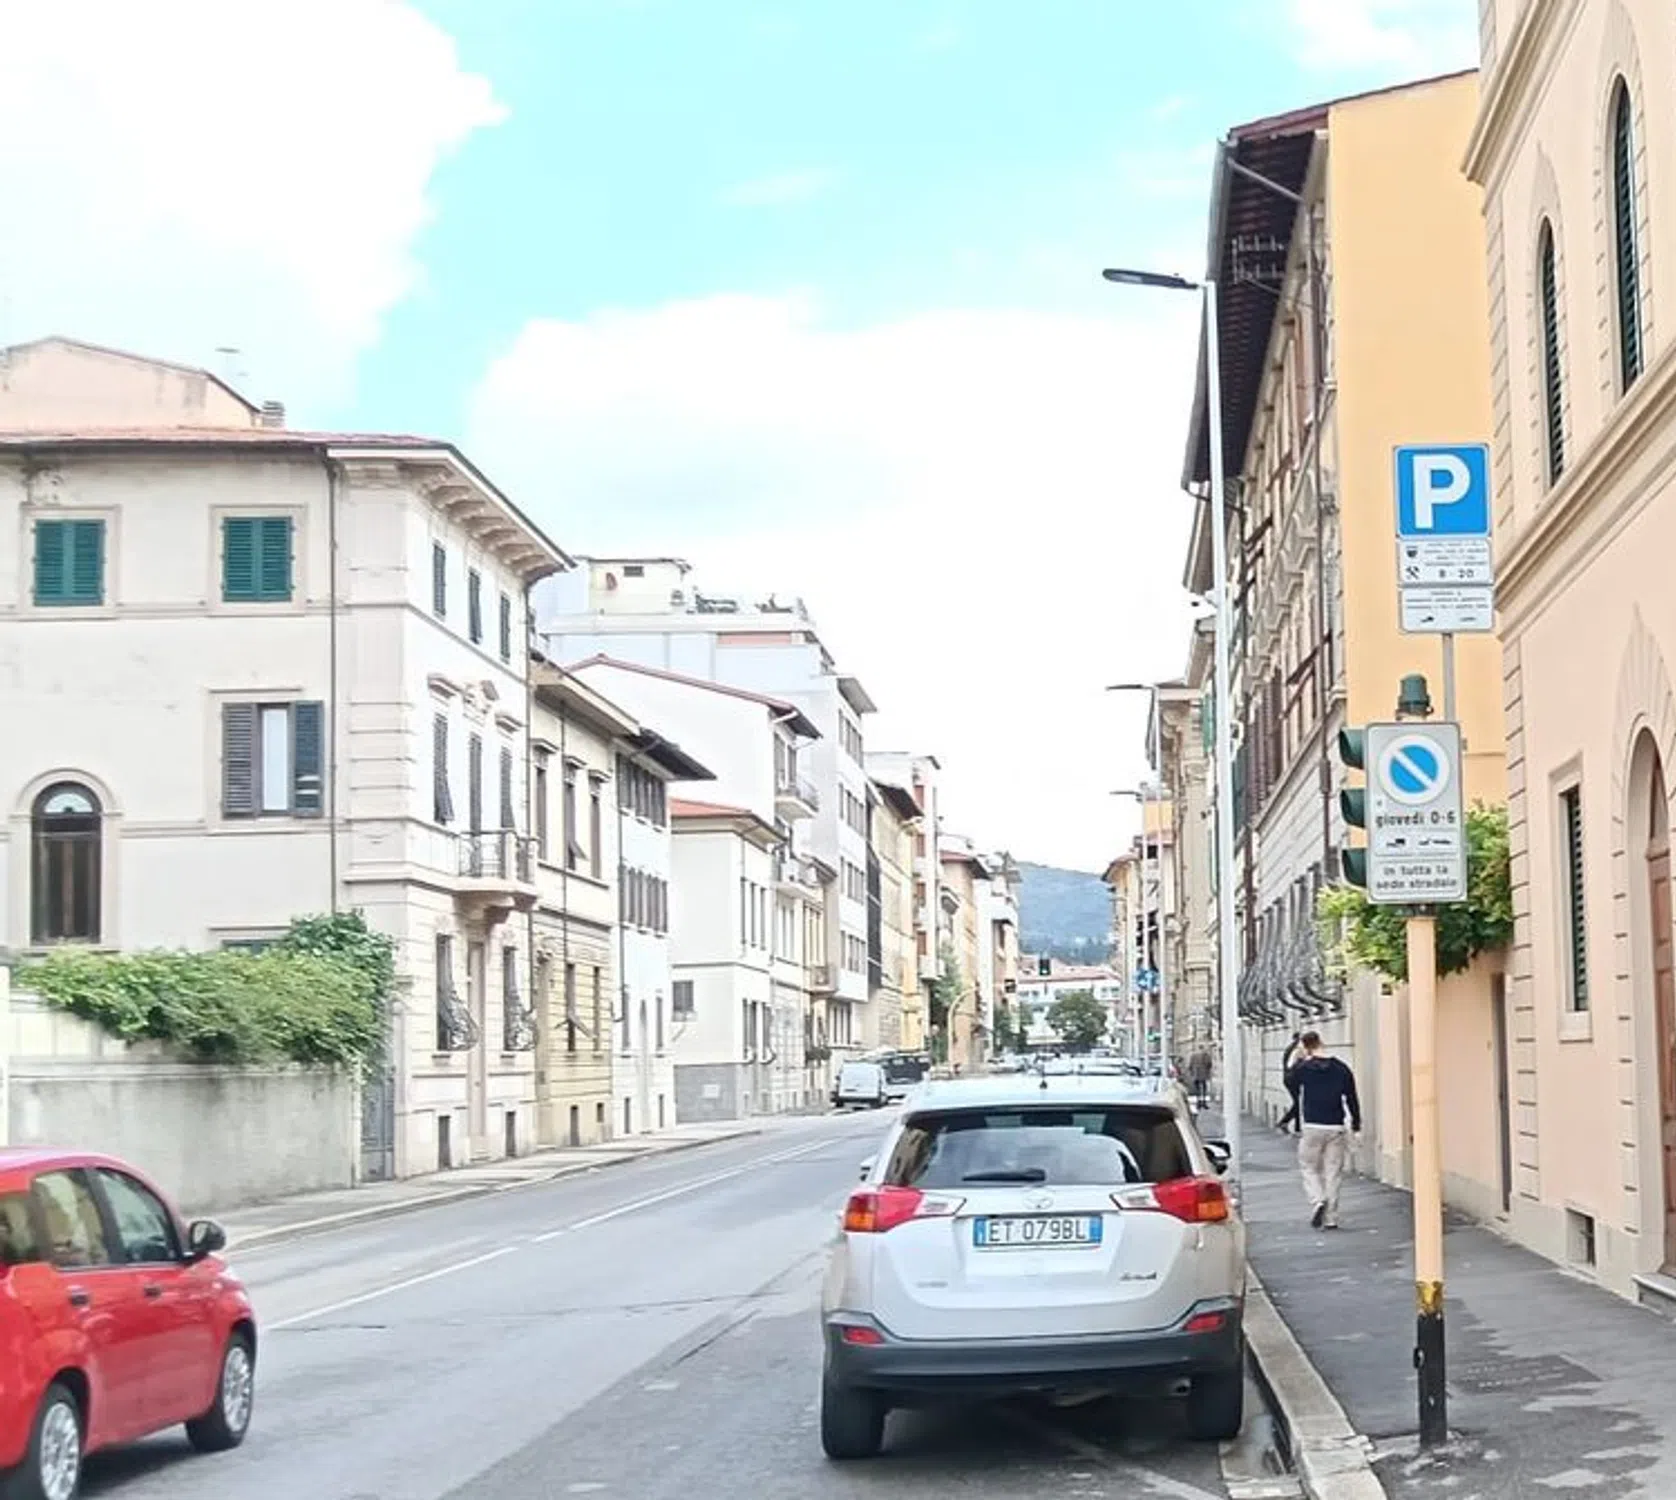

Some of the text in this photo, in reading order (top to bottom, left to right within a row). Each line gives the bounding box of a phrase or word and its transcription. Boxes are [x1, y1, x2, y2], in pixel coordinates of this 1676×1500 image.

[1412, 453, 1472, 530] P
[988, 1219, 1087, 1243] ET 079BL
